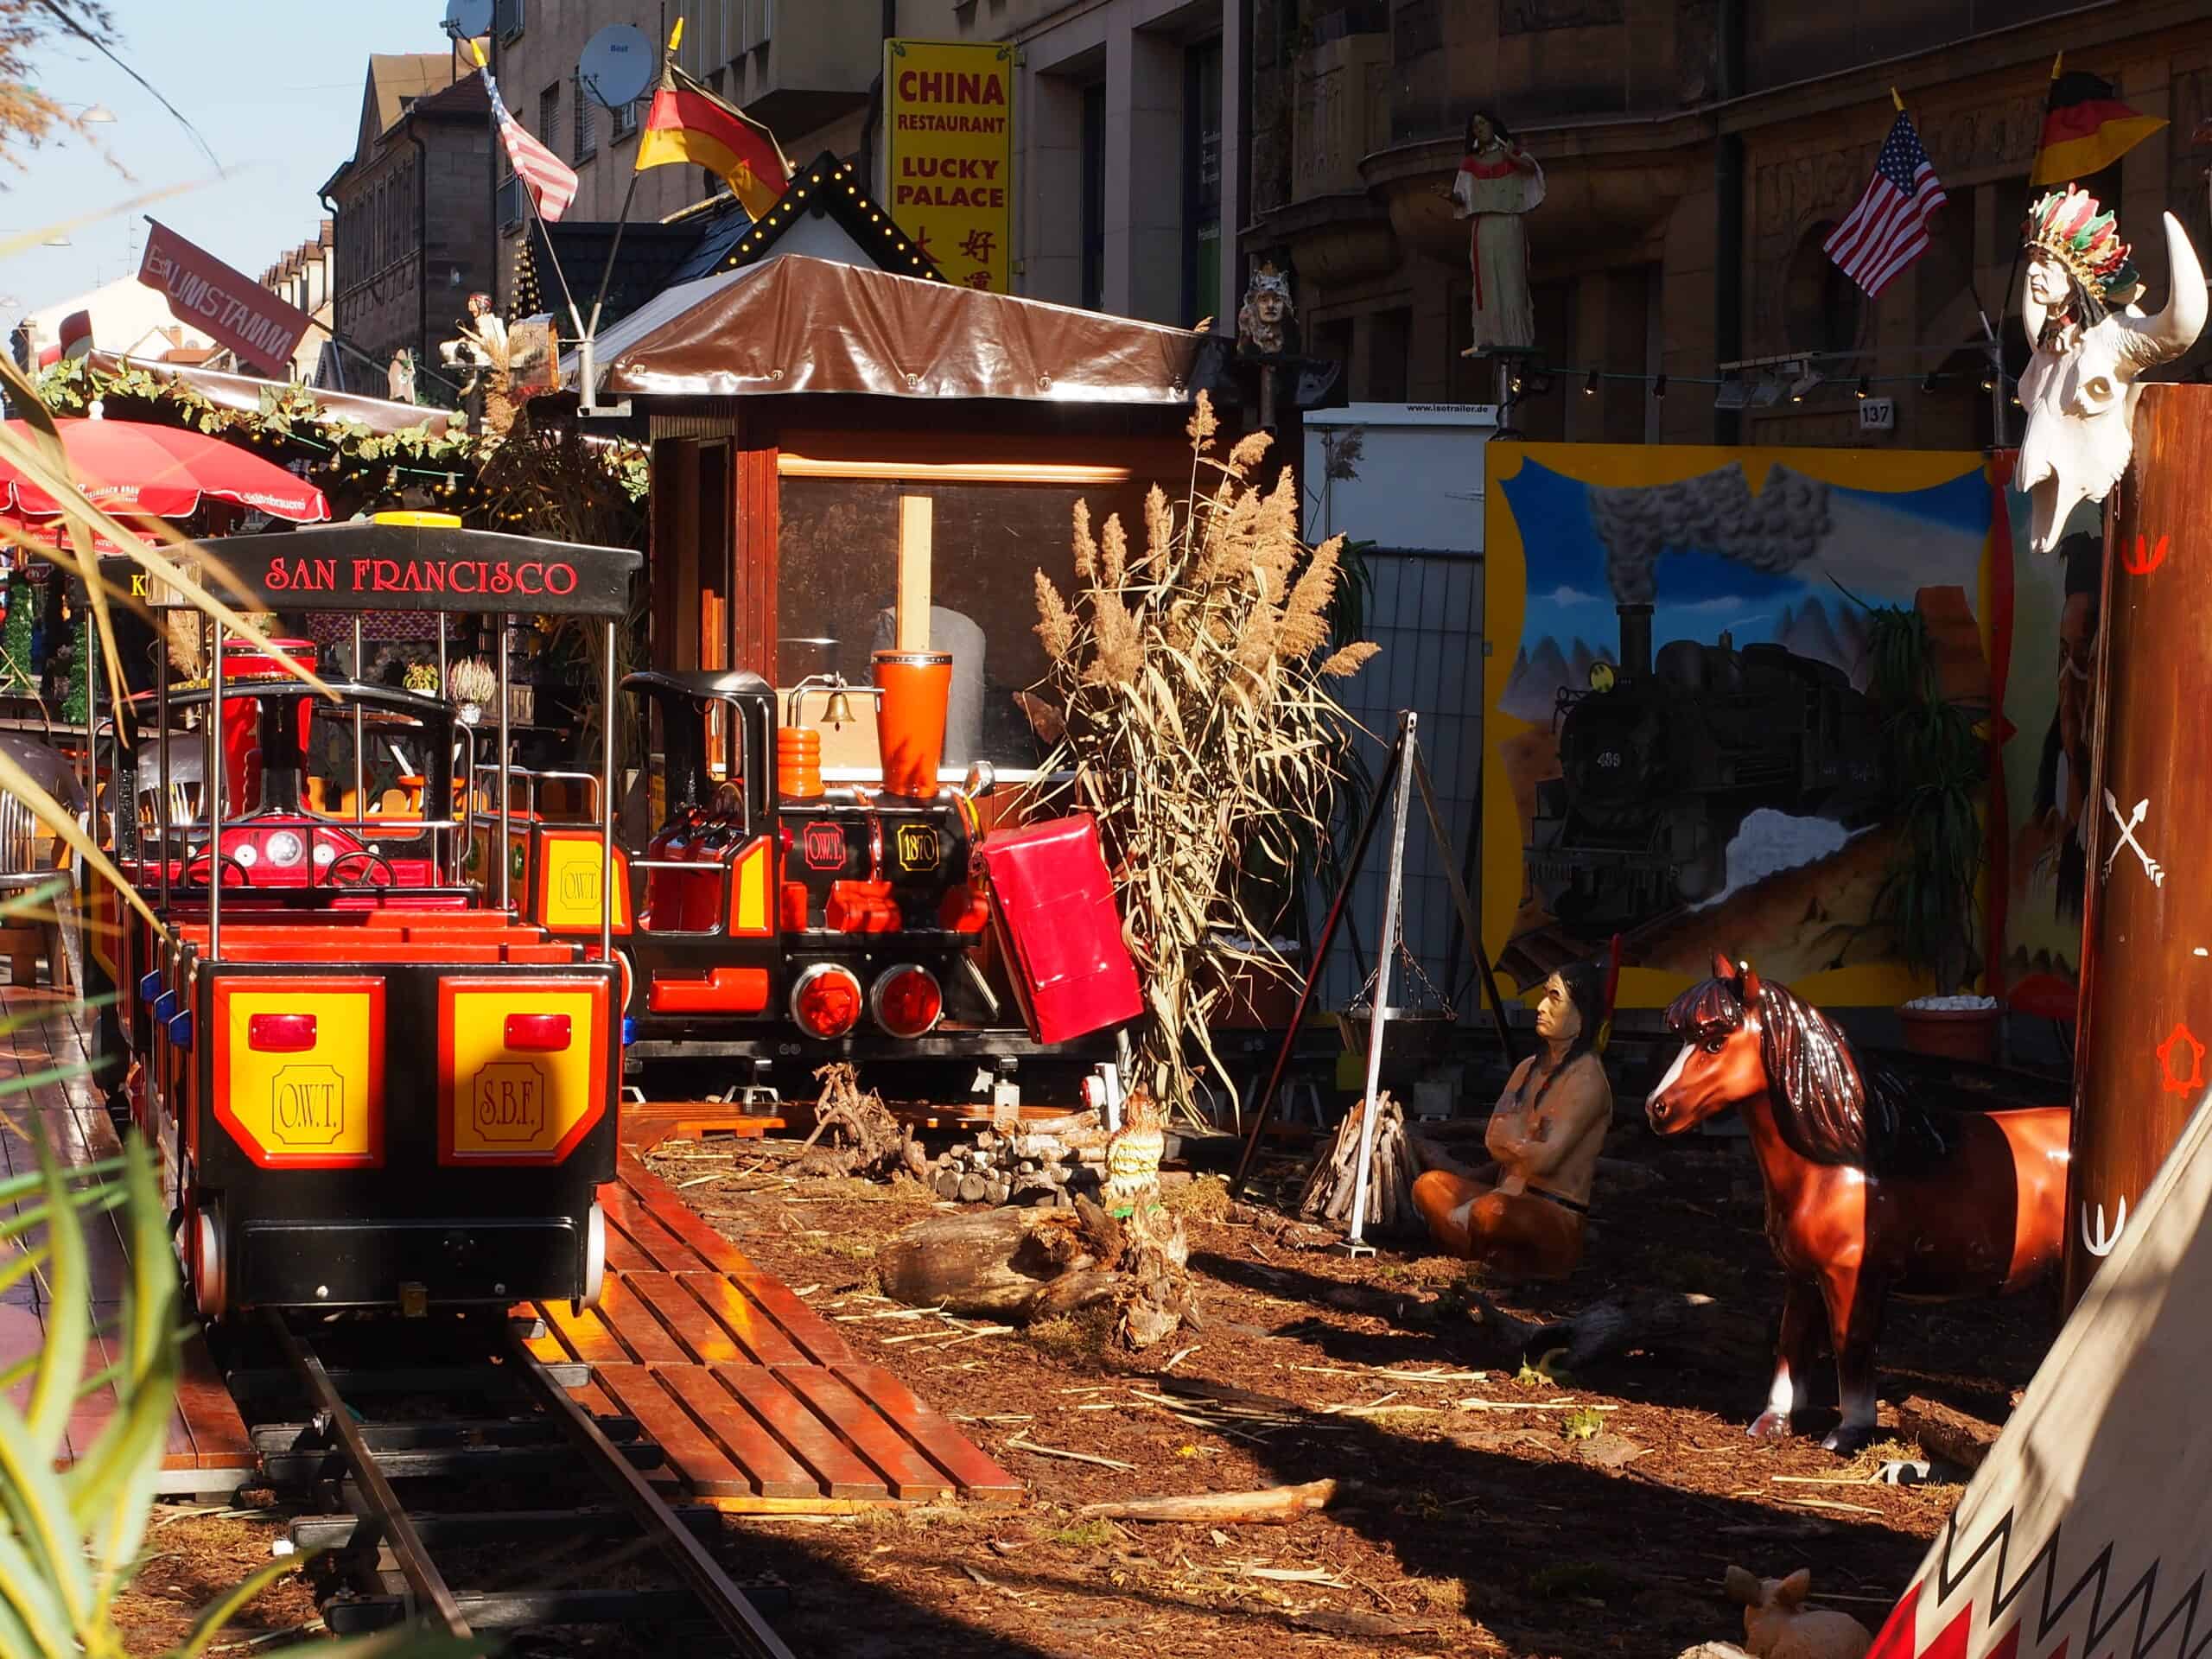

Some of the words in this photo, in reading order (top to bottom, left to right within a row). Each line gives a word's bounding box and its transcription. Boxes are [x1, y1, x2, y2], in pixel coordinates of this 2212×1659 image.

[898, 71, 1006, 105] CHINA
[897, 114, 1006, 133] RESTAURANT
[902, 157, 1000, 180] LUCKY
[897, 185, 1004, 207] PALACE
[1407, 404, 1488, 413] www.isotrailer.de
[1862, 406, 1889, 423] 137
[264, 556, 338, 590] SAN
[352, 558, 579, 595] FRANCISCO
[809, 832, 842, 861] O.W.T.
[904, 834, 935, 861] 1870
[279, 1083, 337, 1128] O.W.T.
[480, 1079, 535, 1126] S.B.F.
